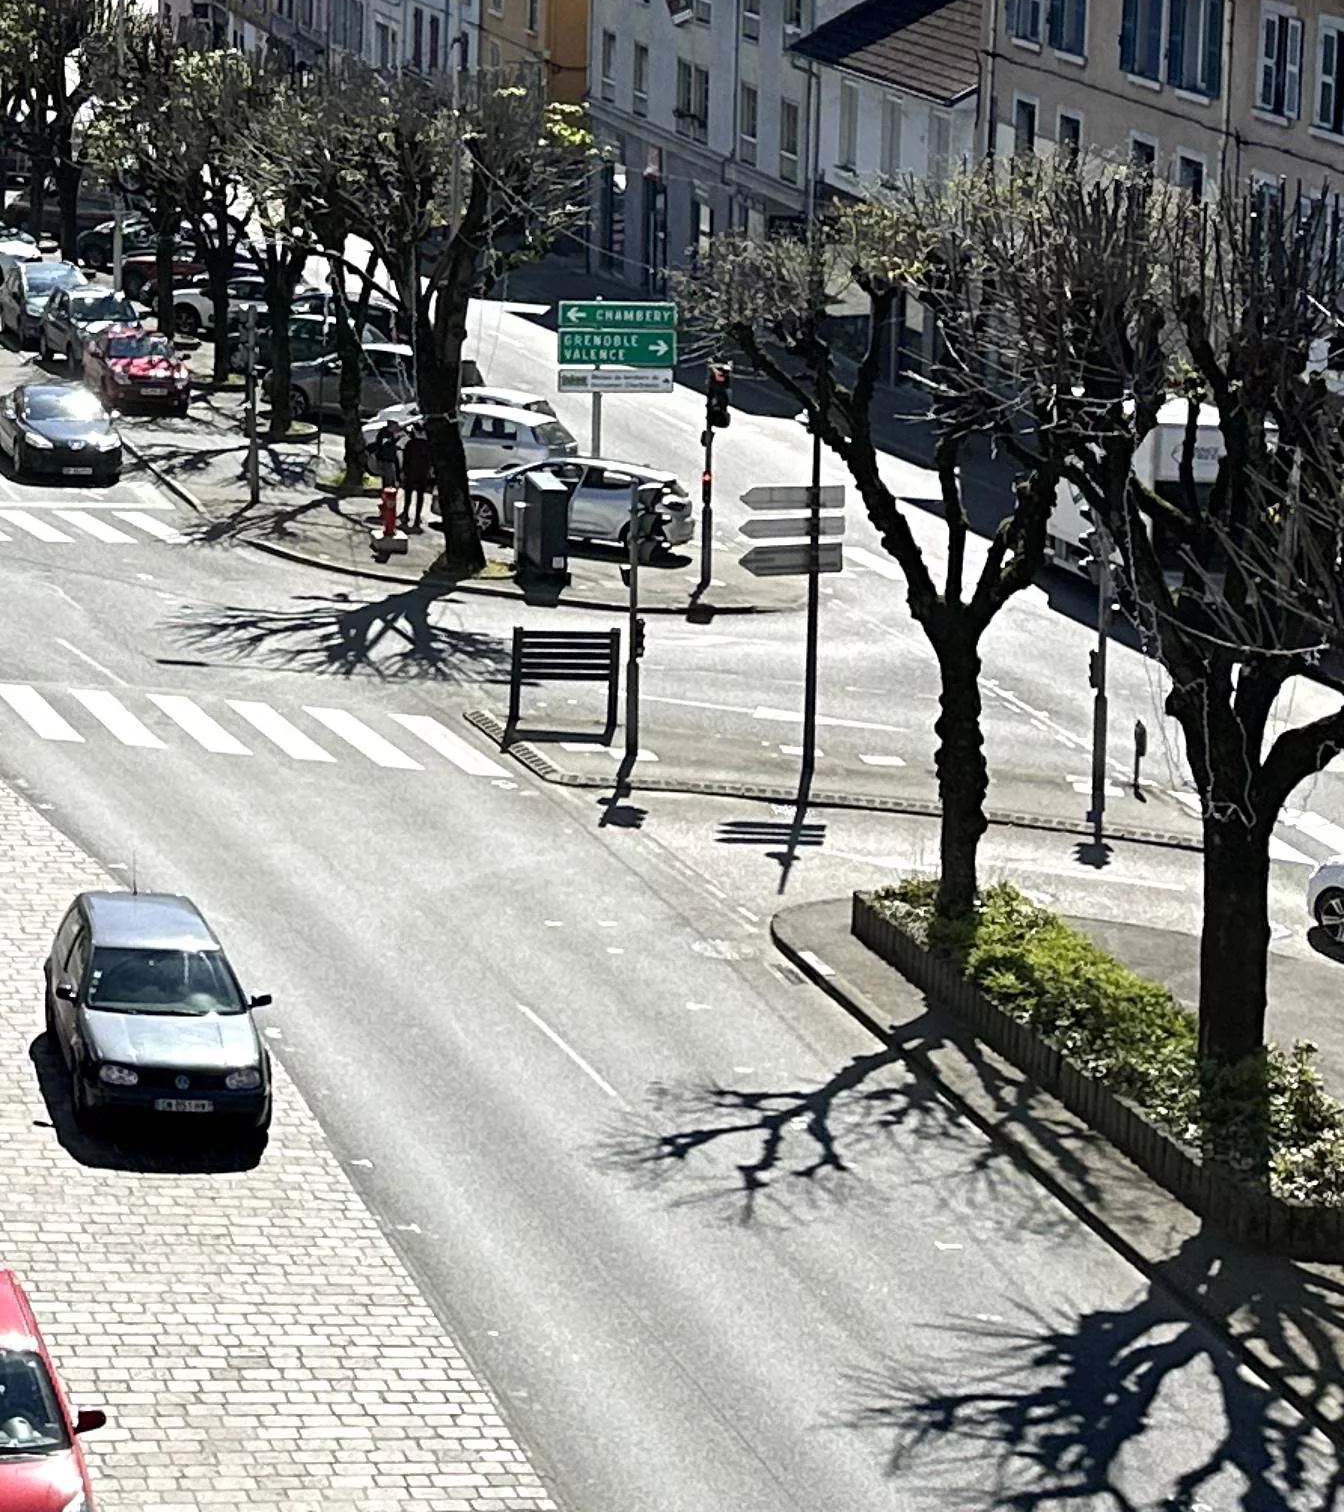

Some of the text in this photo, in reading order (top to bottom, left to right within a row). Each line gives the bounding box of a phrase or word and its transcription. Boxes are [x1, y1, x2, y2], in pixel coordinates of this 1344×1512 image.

[595, 309, 671, 322] CHAMBERY
[563, 335, 640, 347] GRENOBLE
[563, 349, 626, 361] VALENCE
